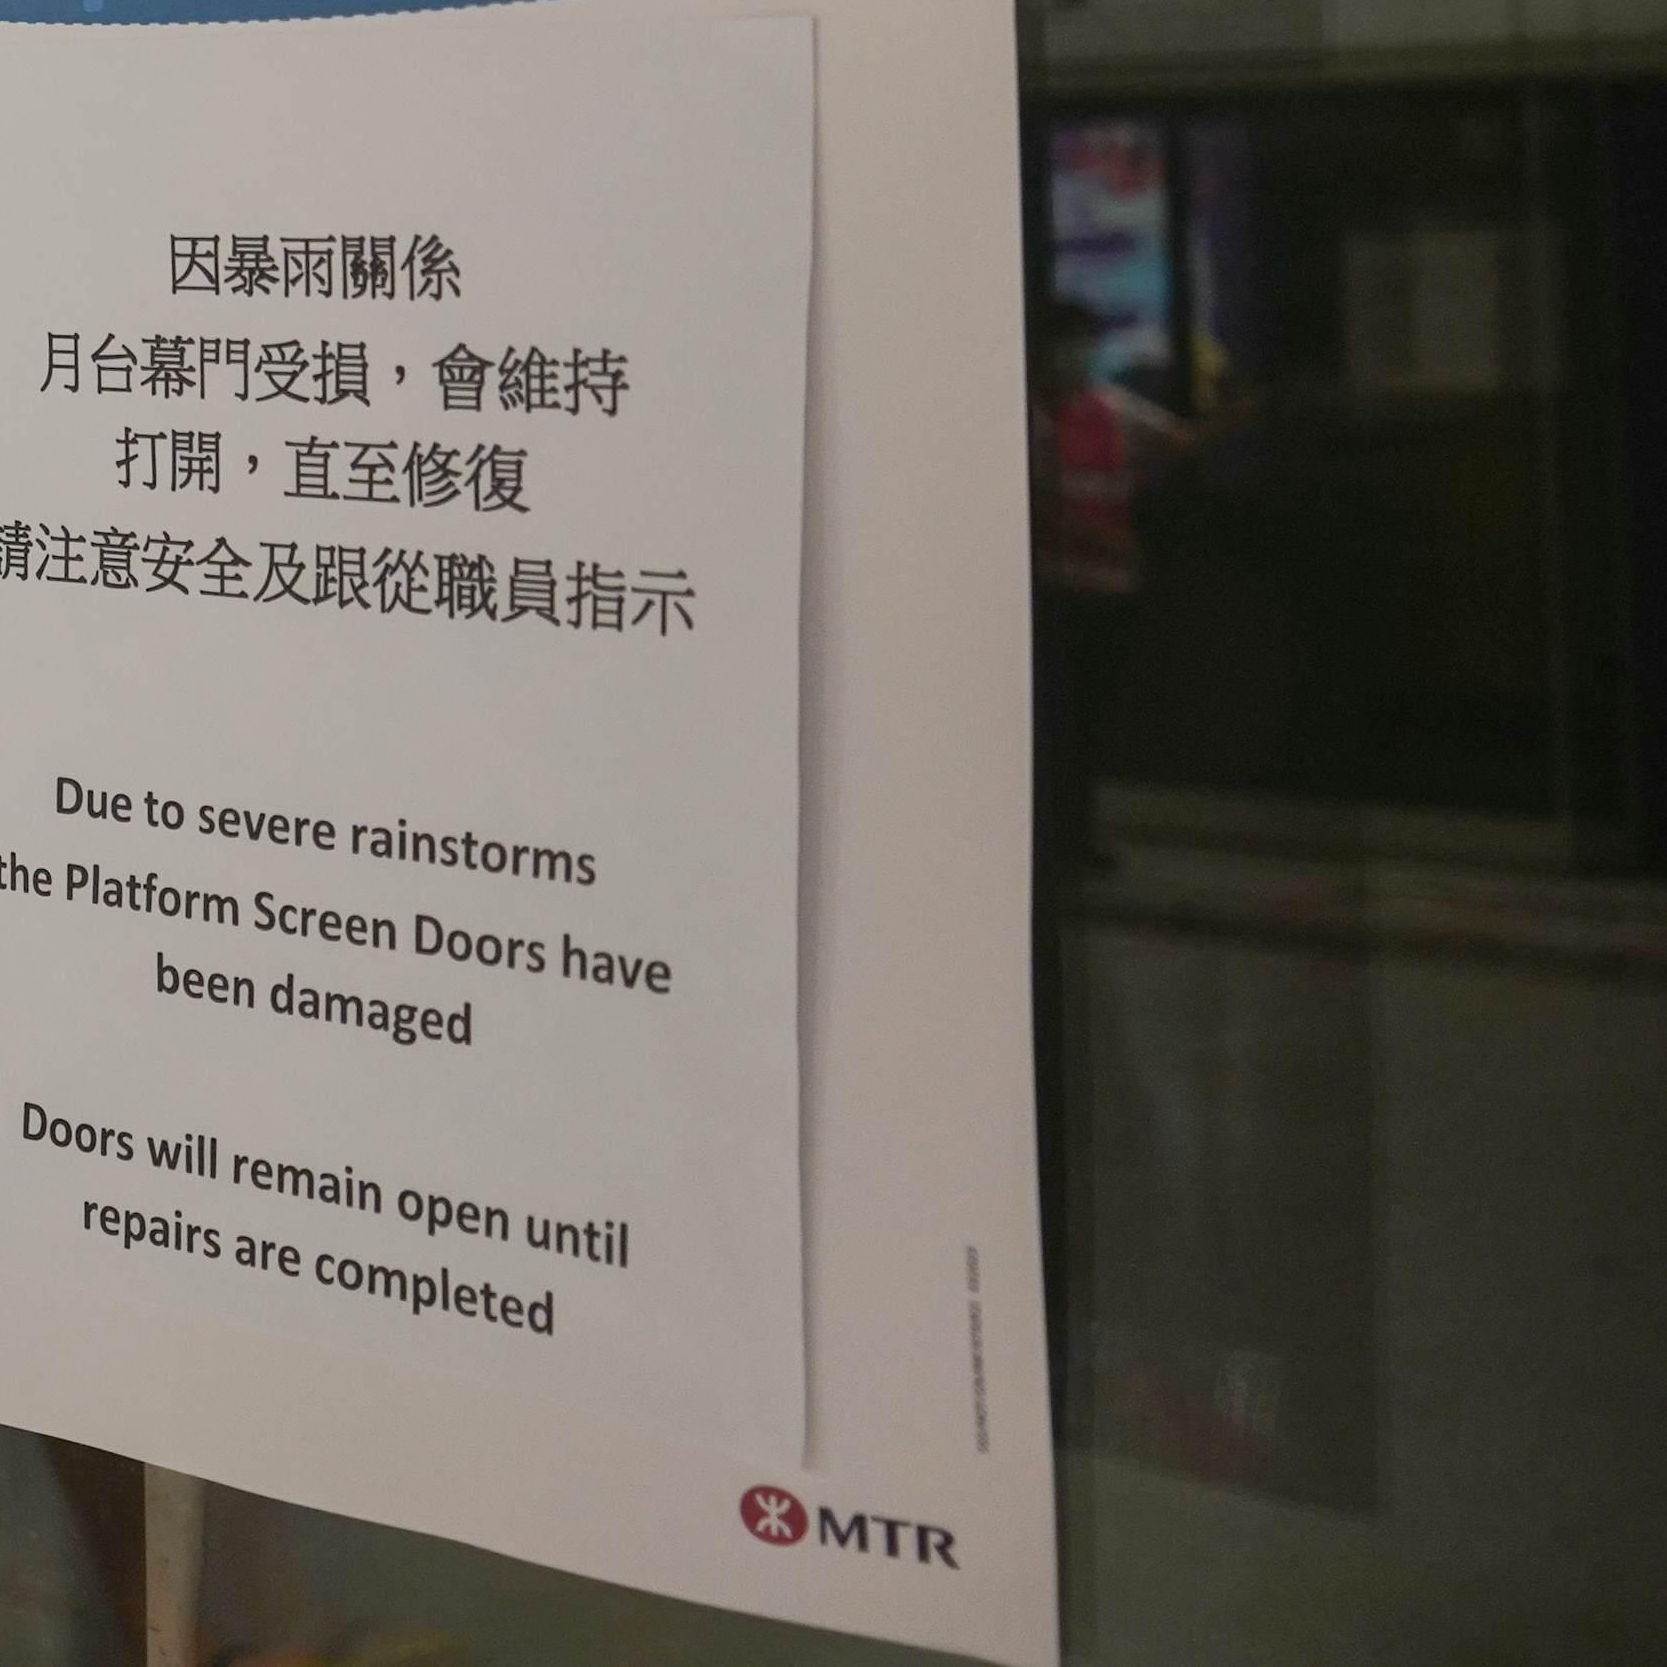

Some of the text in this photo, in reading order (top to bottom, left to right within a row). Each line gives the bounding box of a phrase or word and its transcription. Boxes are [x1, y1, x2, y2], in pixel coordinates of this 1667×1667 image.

[169, 233, 462, 301] 因暴雨關係
[40, 332, 632, 417] 月台幕門受損，會維持
[115, 427, 533, 513] 打開，直至修復
[56, 776, 598, 886] Due to severe rainstorms
[65, 863, 240, 927] Platform
[253, 891, 398, 950] Screen
[414, 913, 547, 974] Doors
[561, 934, 673, 995] have
[156, 952, 474, 1046] been damaged
[22, 1102, 630, 1269] Doors will remain open until
[82, 1197, 555, 1338] repairs are completed
[818, 1504, 961, 1571] MTR
